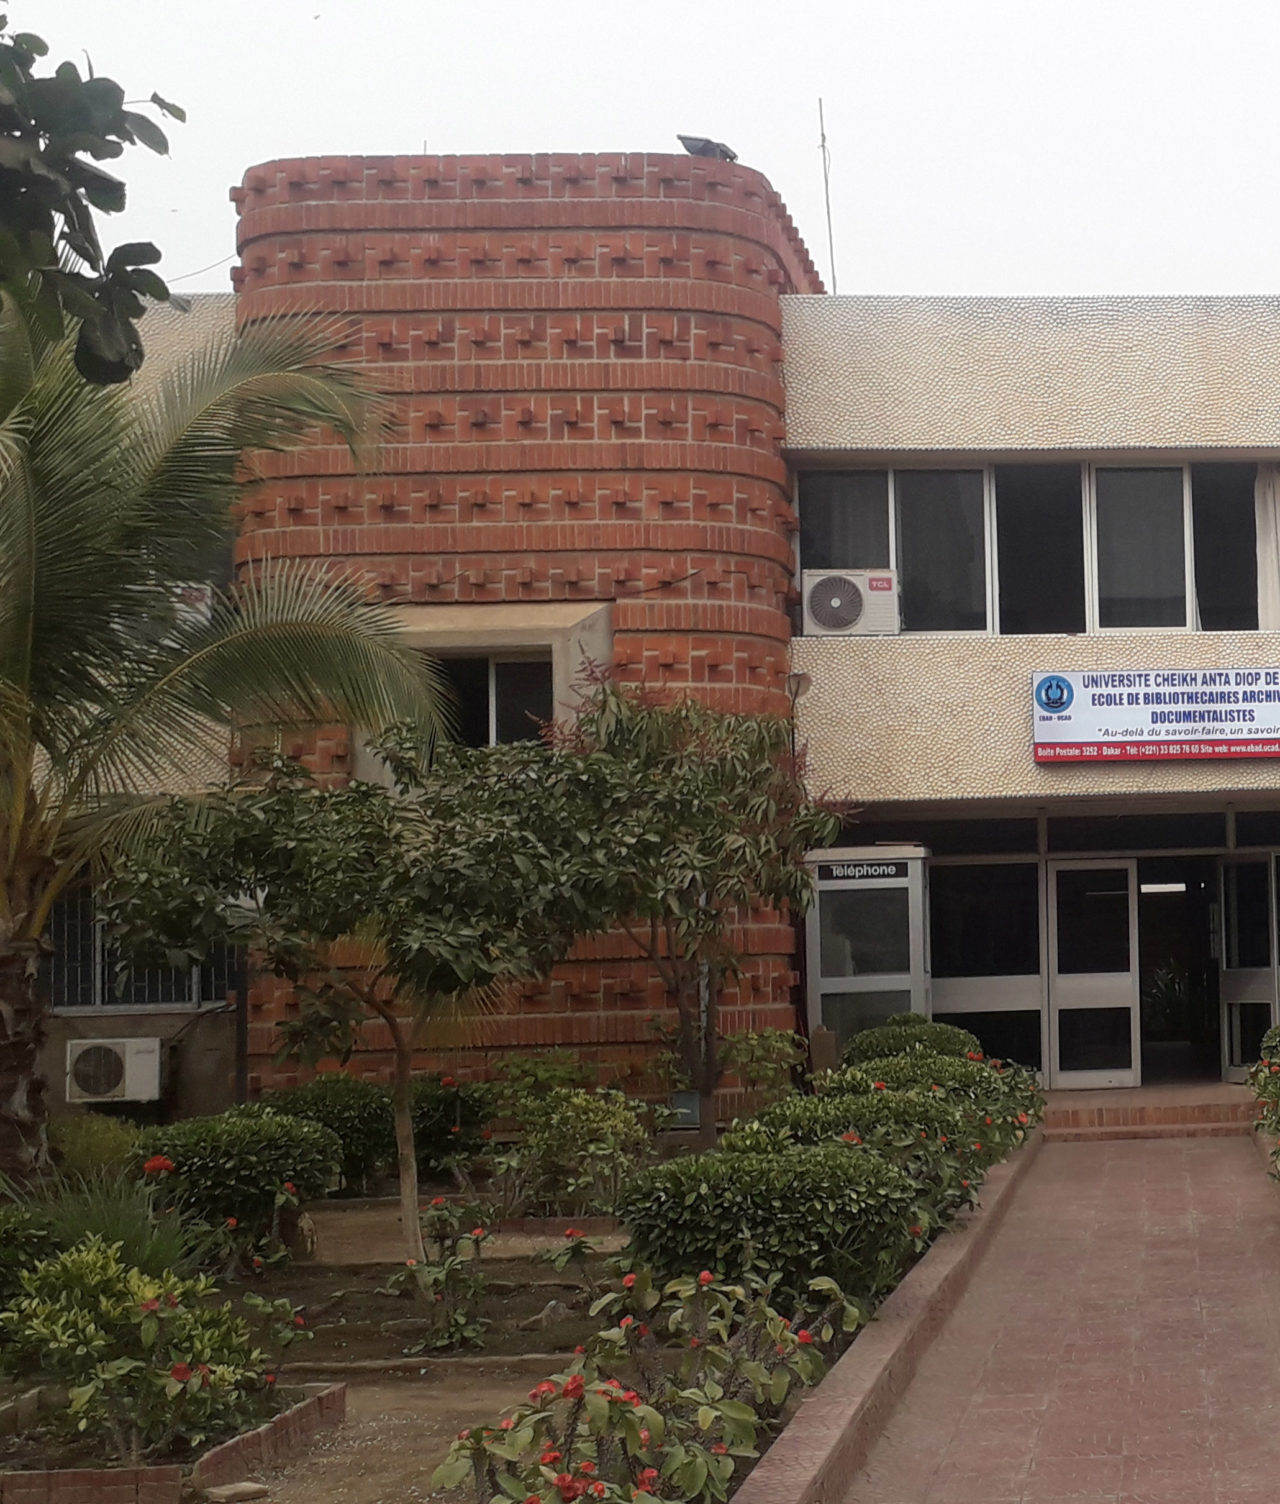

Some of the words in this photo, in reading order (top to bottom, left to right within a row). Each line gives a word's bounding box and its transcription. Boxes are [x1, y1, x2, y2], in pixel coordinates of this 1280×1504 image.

[1083, 673, 1151, 688] UNIVERSITE
[1154, 673, 1197, 688] CHEIKH
[1201, 672, 1231, 687] ANTA
[1235, 672, 1261, 686] DIOP
[1265, 671, 1279, 685] DE
[1092, 693, 1124, 706] ECOLE
[1127, 692, 1141, 706] DE
[1143, 690, 1239, 706] BIBLIOTHECAIRES
[1151, 709, 1256, 724] DOCUMENTALISTES
[1147, 727, 1161, 737] du
[1082, 746, 1098, 756] 3252
[1102, 746, 1121, 755] Dakar
[1140, 745, 1159, 756] (+221)
[1160, 745, 1168, 754] 33
[830, 864, 897, 878] Téléphone
